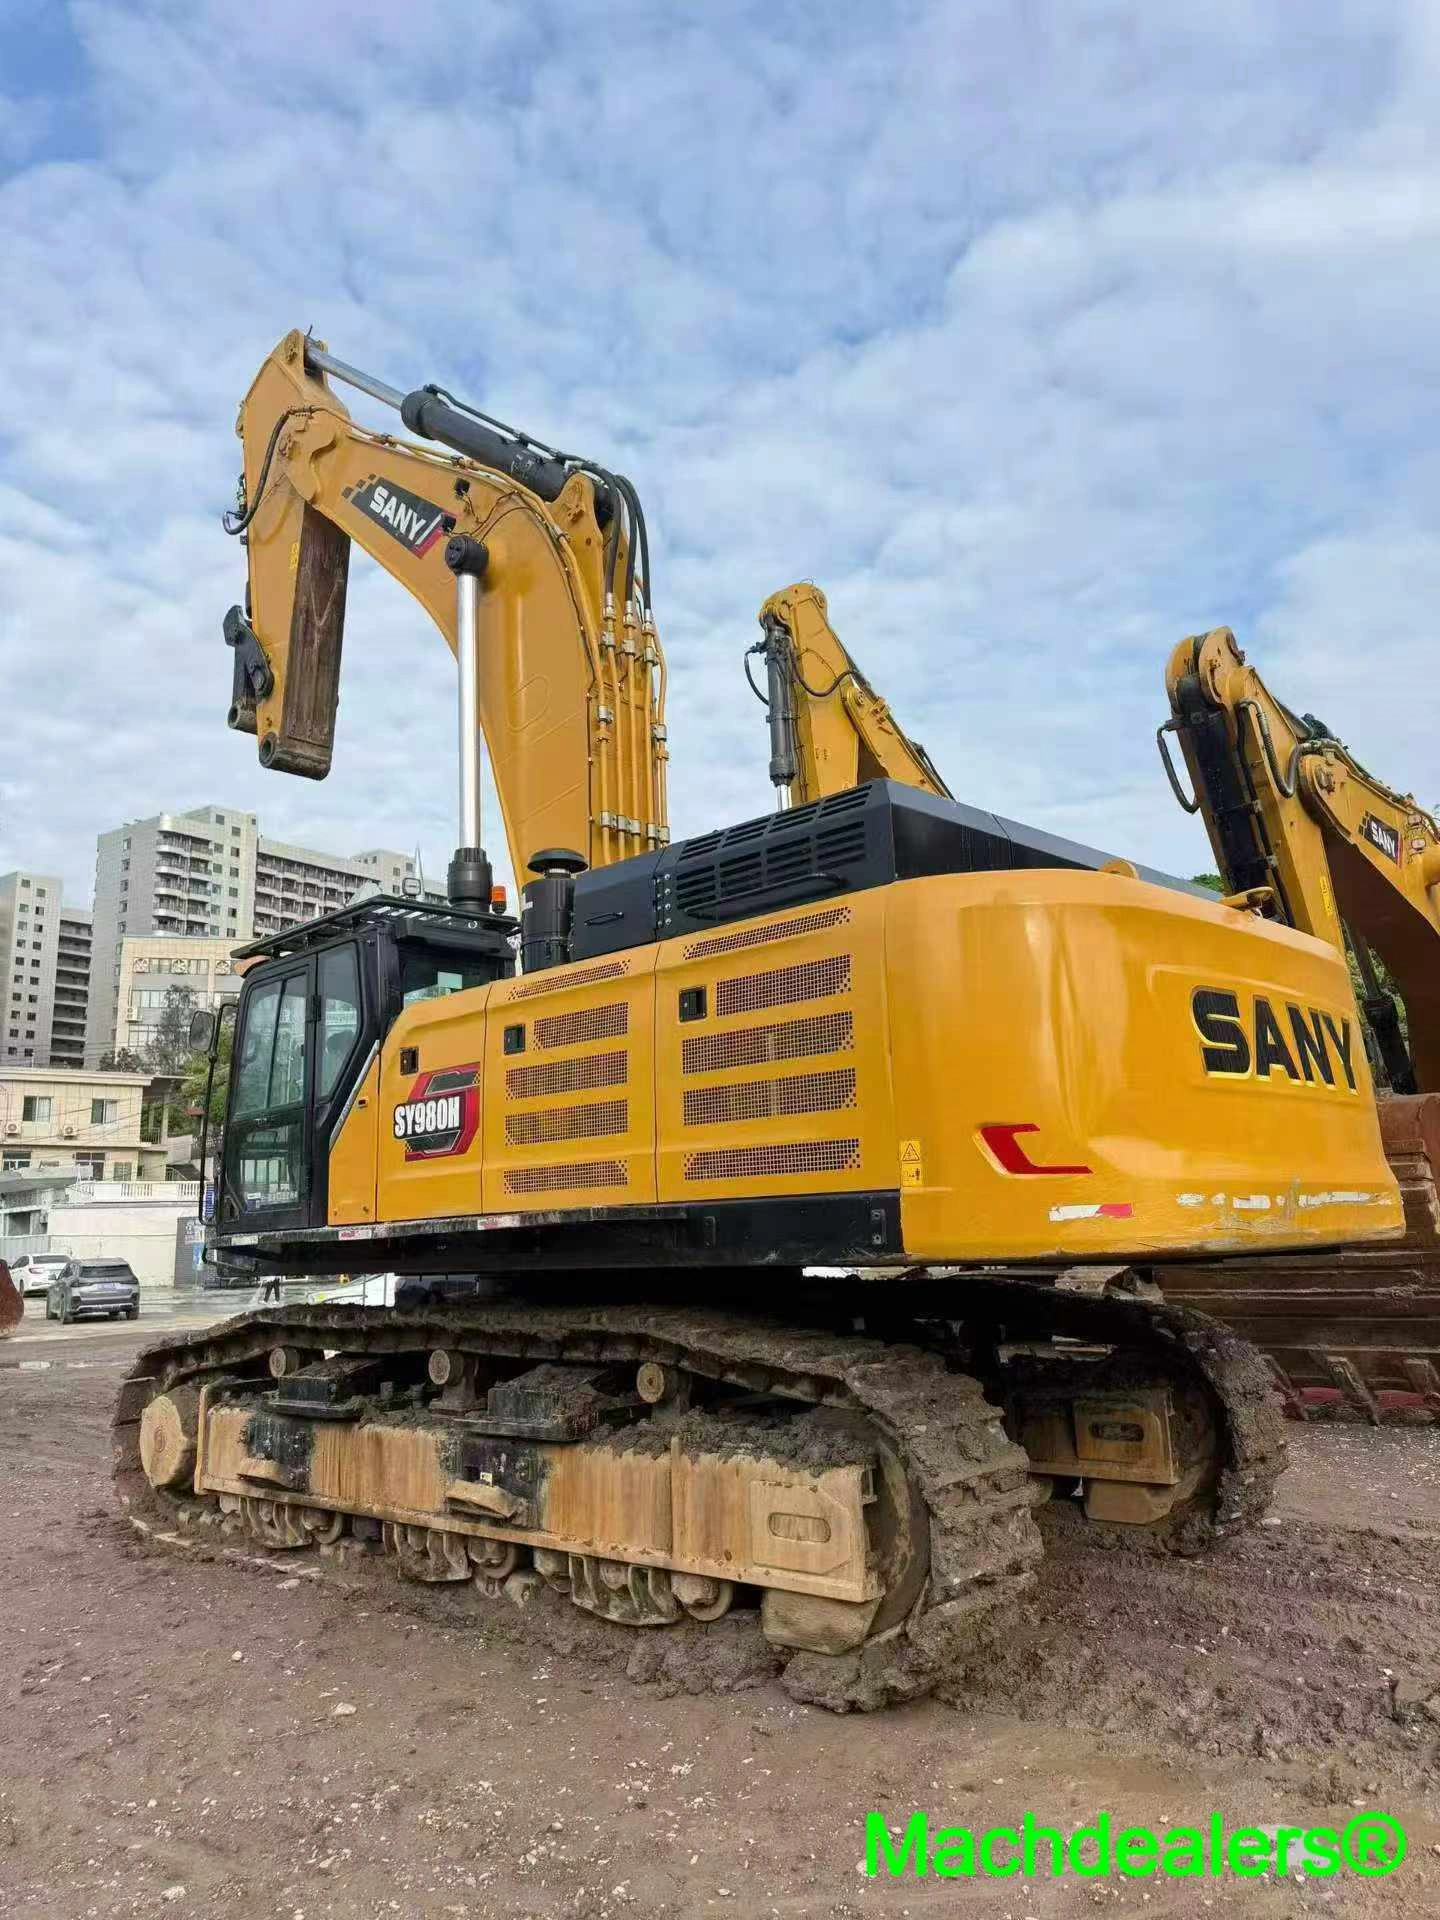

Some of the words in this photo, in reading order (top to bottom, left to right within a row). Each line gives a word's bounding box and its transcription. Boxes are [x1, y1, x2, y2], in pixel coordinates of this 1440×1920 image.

[369, 485, 427, 541] SANY
[1371, 820, 1396, 858] SANY
[1191, 985, 1358, 1094] SANY
[394, 1096, 460, 1137] SY980H
